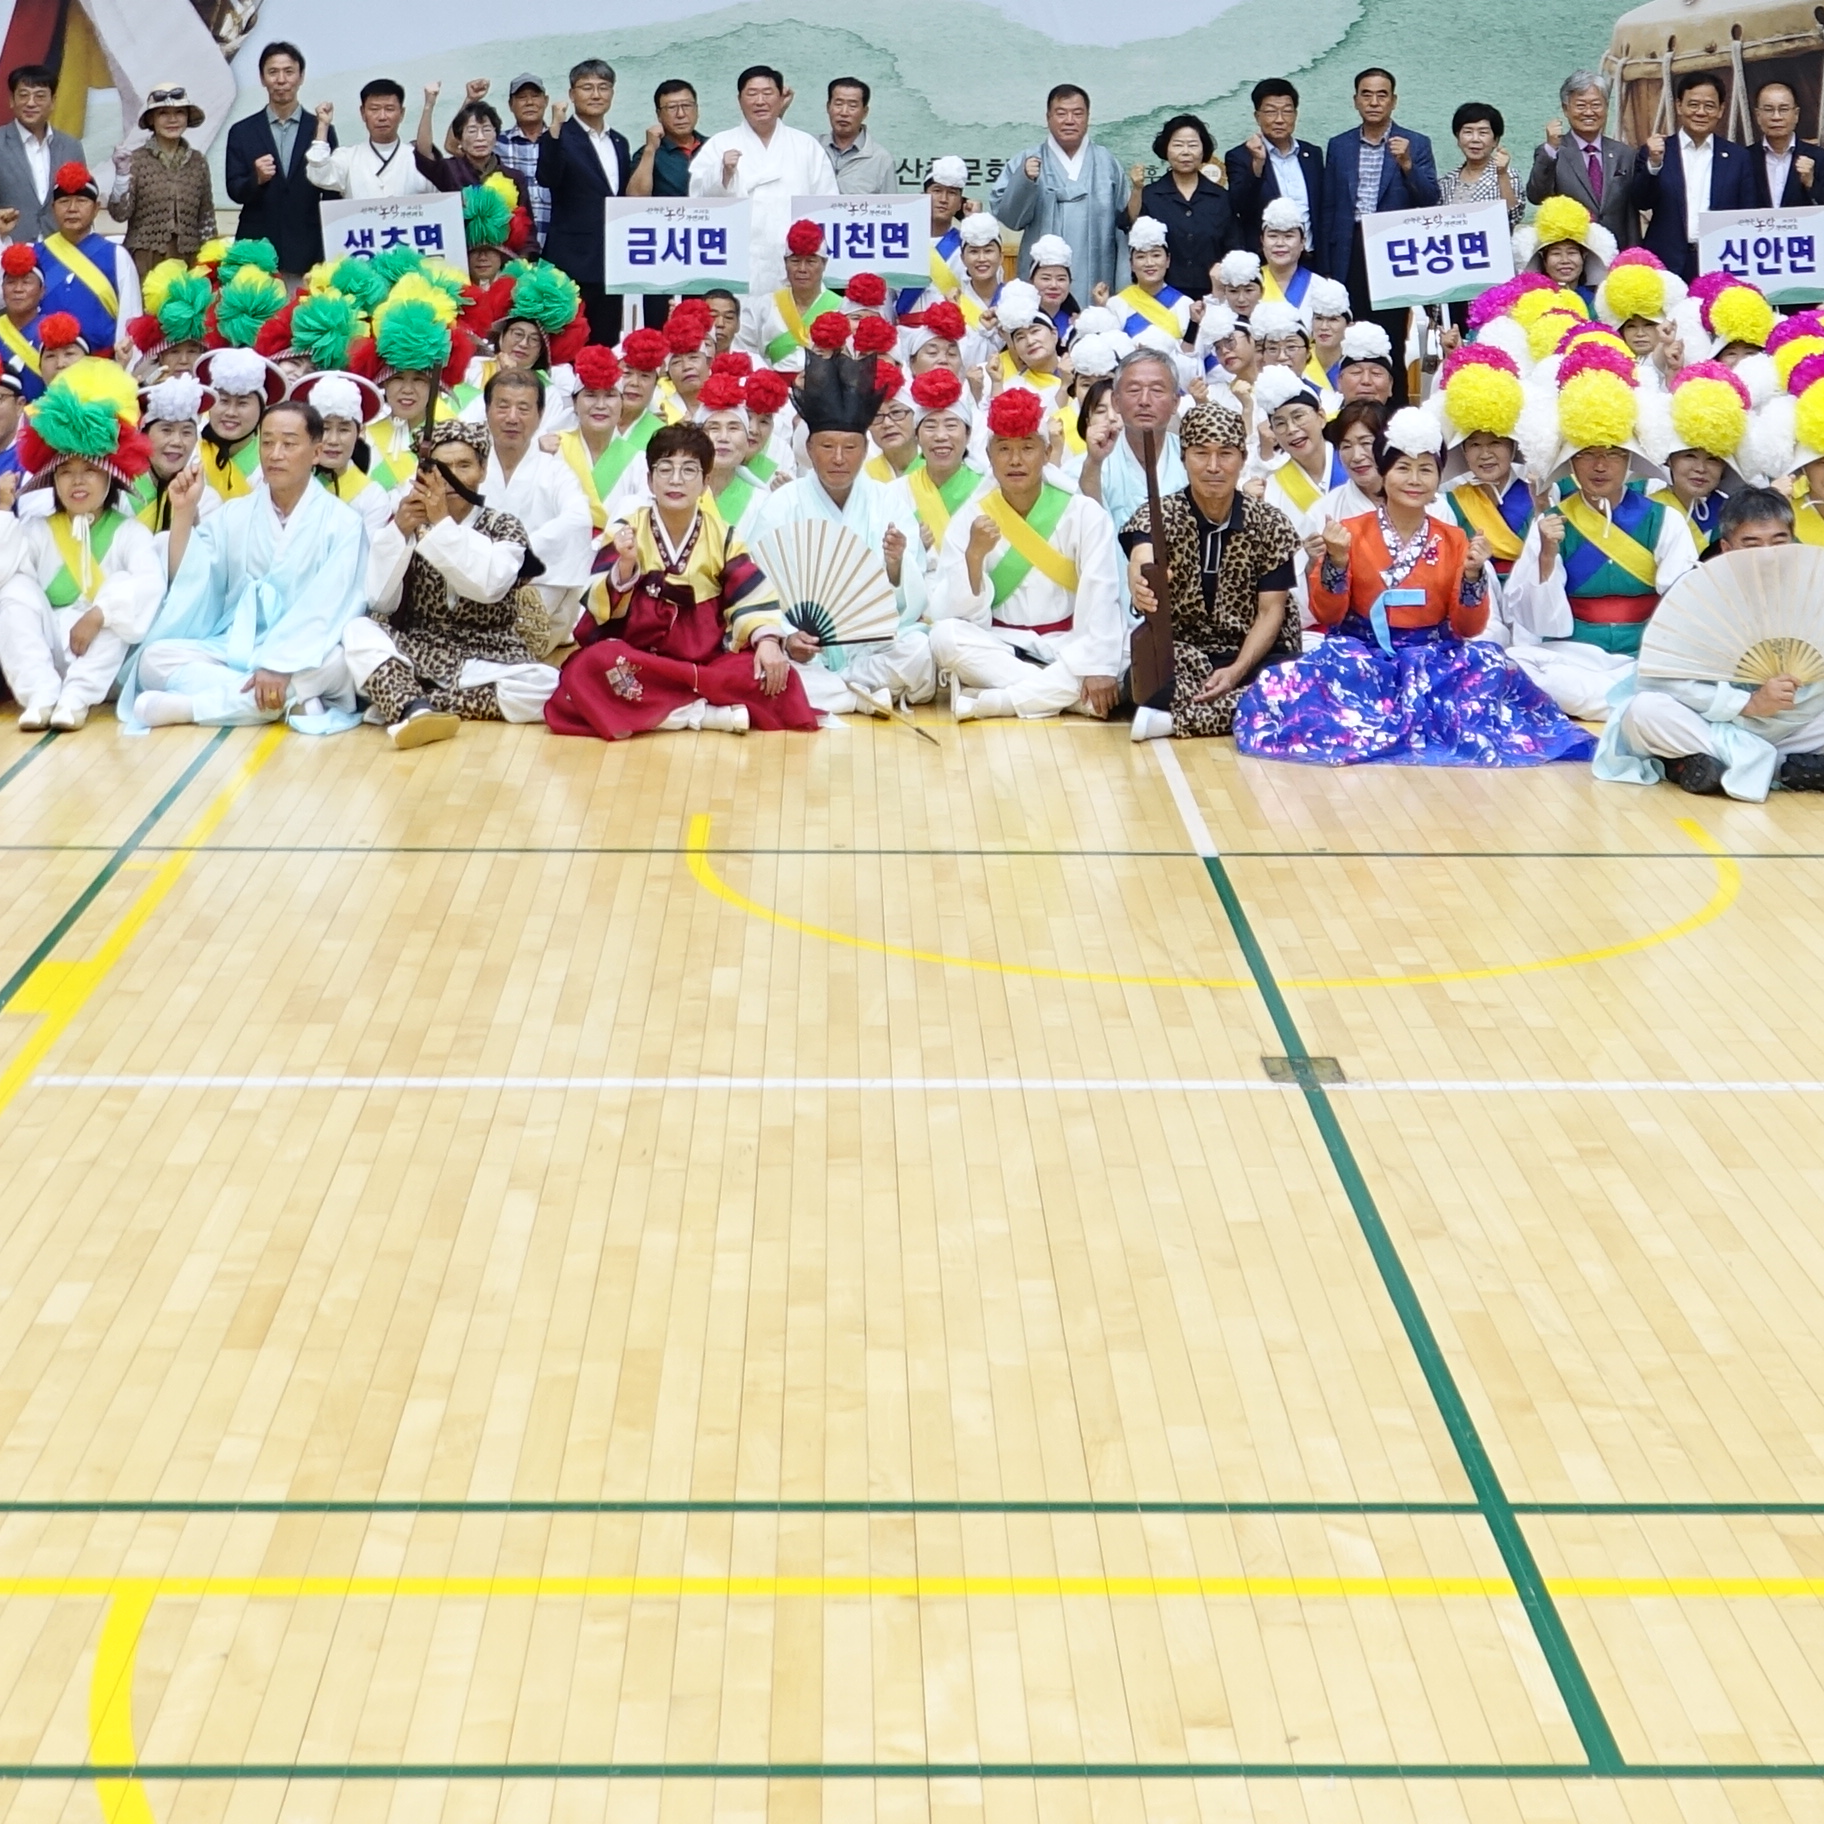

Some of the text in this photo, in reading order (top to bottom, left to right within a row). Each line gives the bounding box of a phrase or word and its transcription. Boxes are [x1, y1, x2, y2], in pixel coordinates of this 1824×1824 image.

[625, 226, 729, 266] 금서면
[1386, 232, 1491, 278] 단성면
[1717, 233, 1818, 276] 신안면
